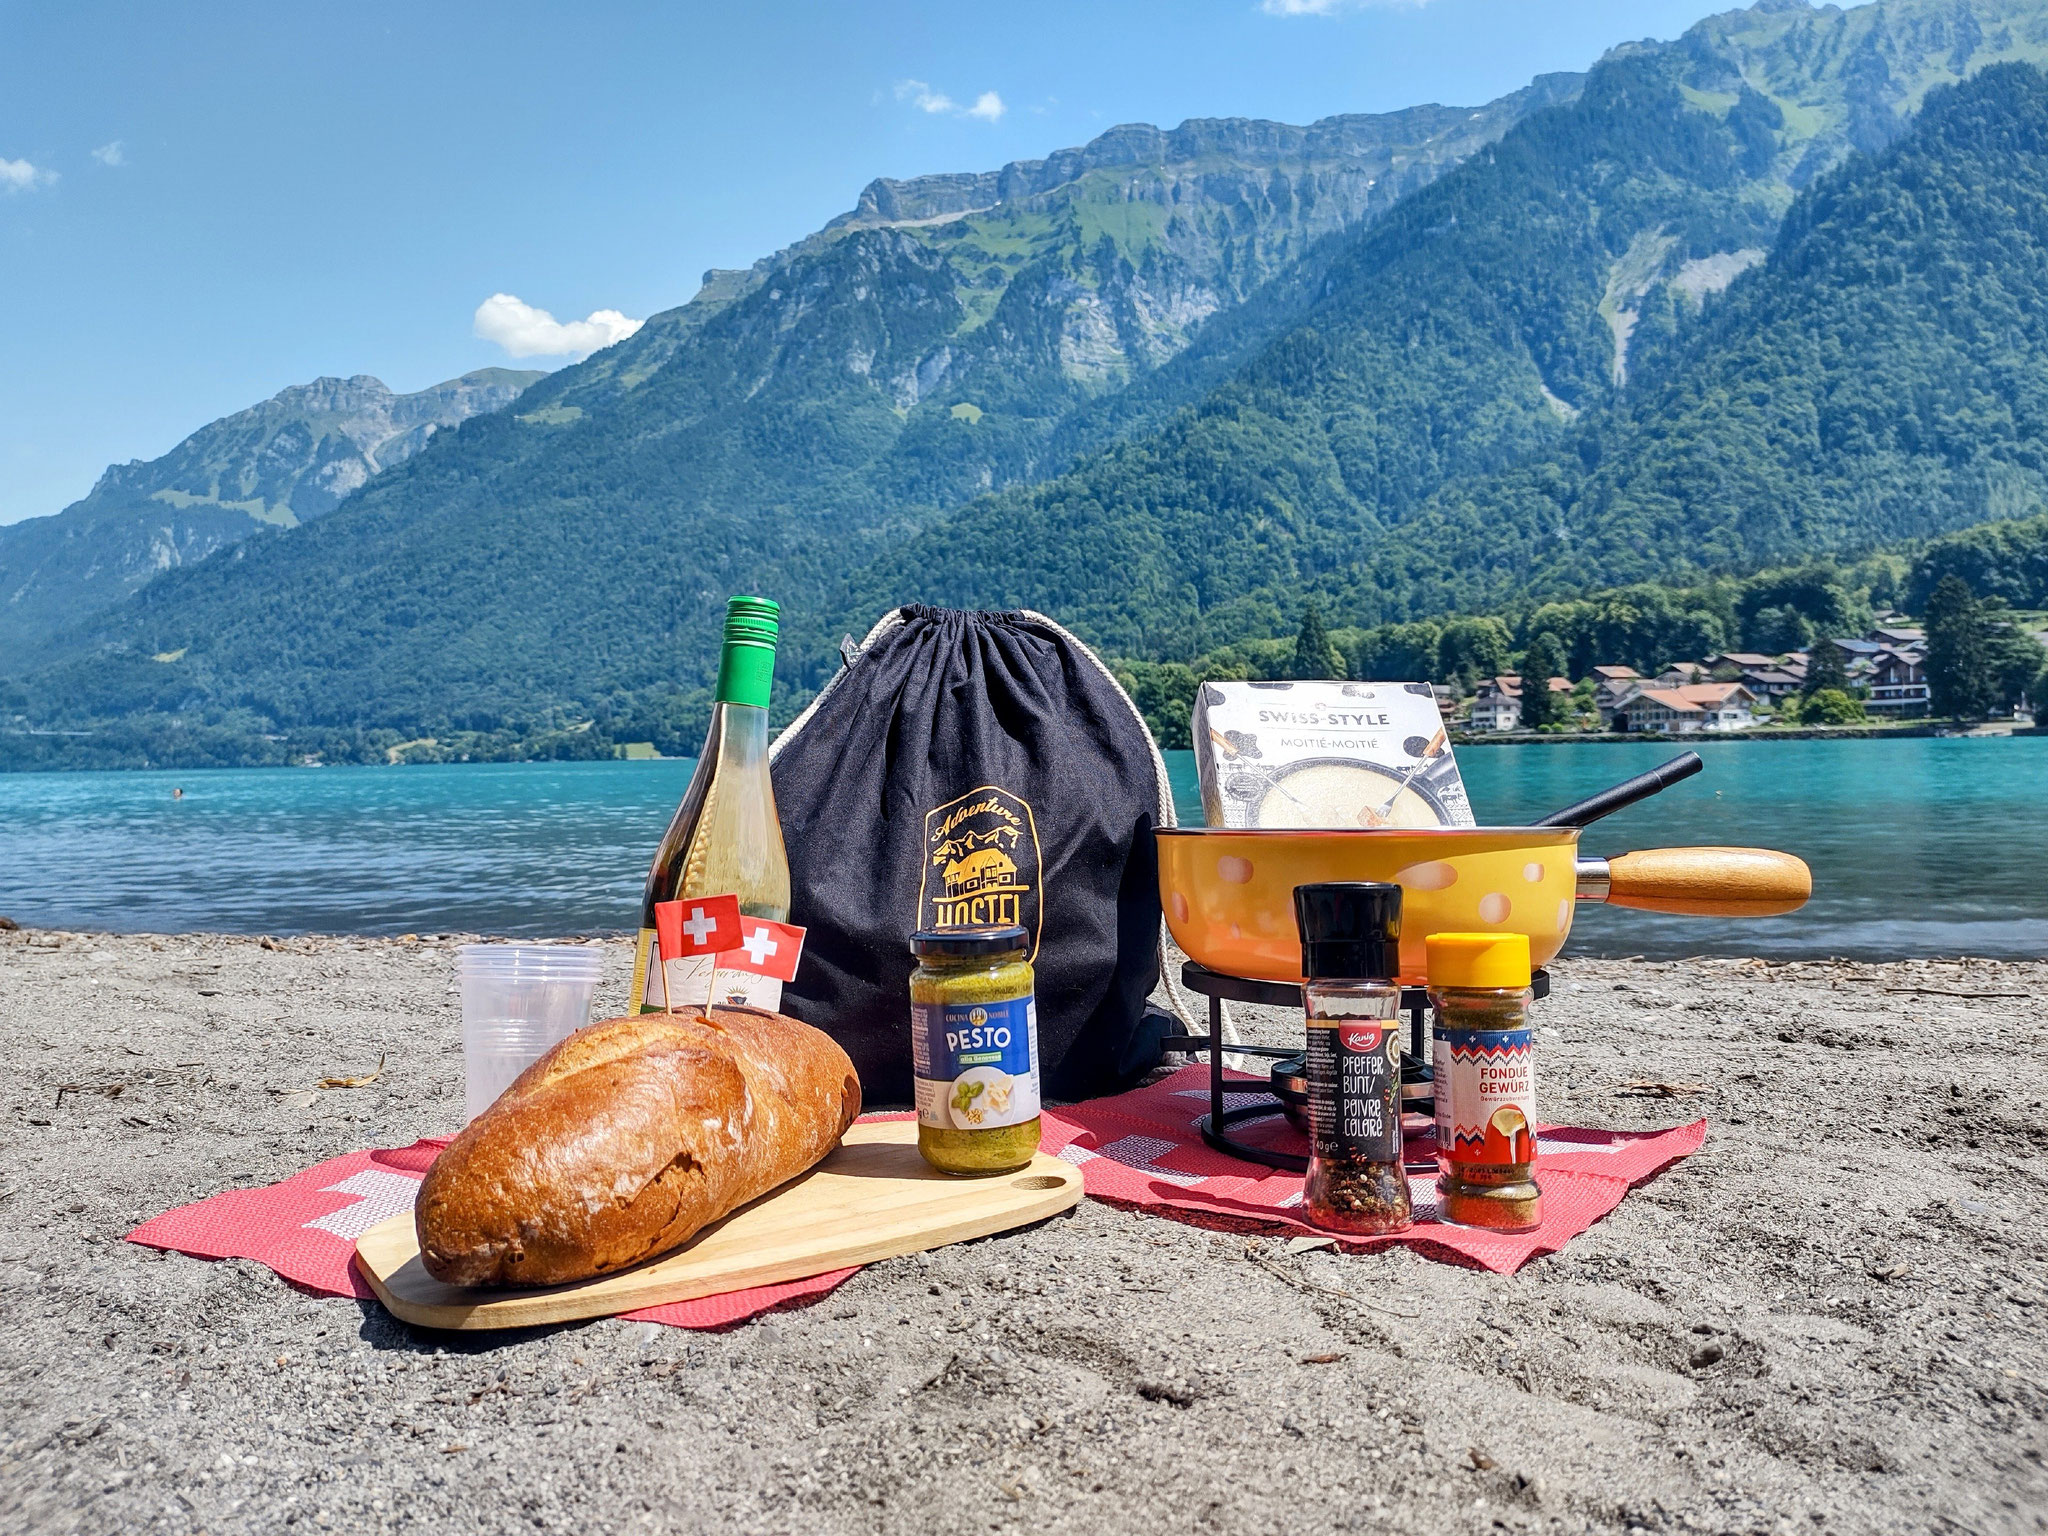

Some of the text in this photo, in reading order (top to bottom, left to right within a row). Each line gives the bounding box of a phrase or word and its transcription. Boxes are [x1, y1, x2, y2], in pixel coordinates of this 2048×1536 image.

[1258, 709, 1391, 726] SWISS-STYLE
[1280, 737, 1380, 749] MOITIÉ-MOITIÉ
[930, 797, 1023, 842] Adventure
[945, 1012, 969, 1022] CUCINA
[945, 1026, 1012, 1052] PESTO
[1480, 1066, 1528, 1079] FONDUE
[1479, 1080, 1530, 1094] GEWÜRZ
